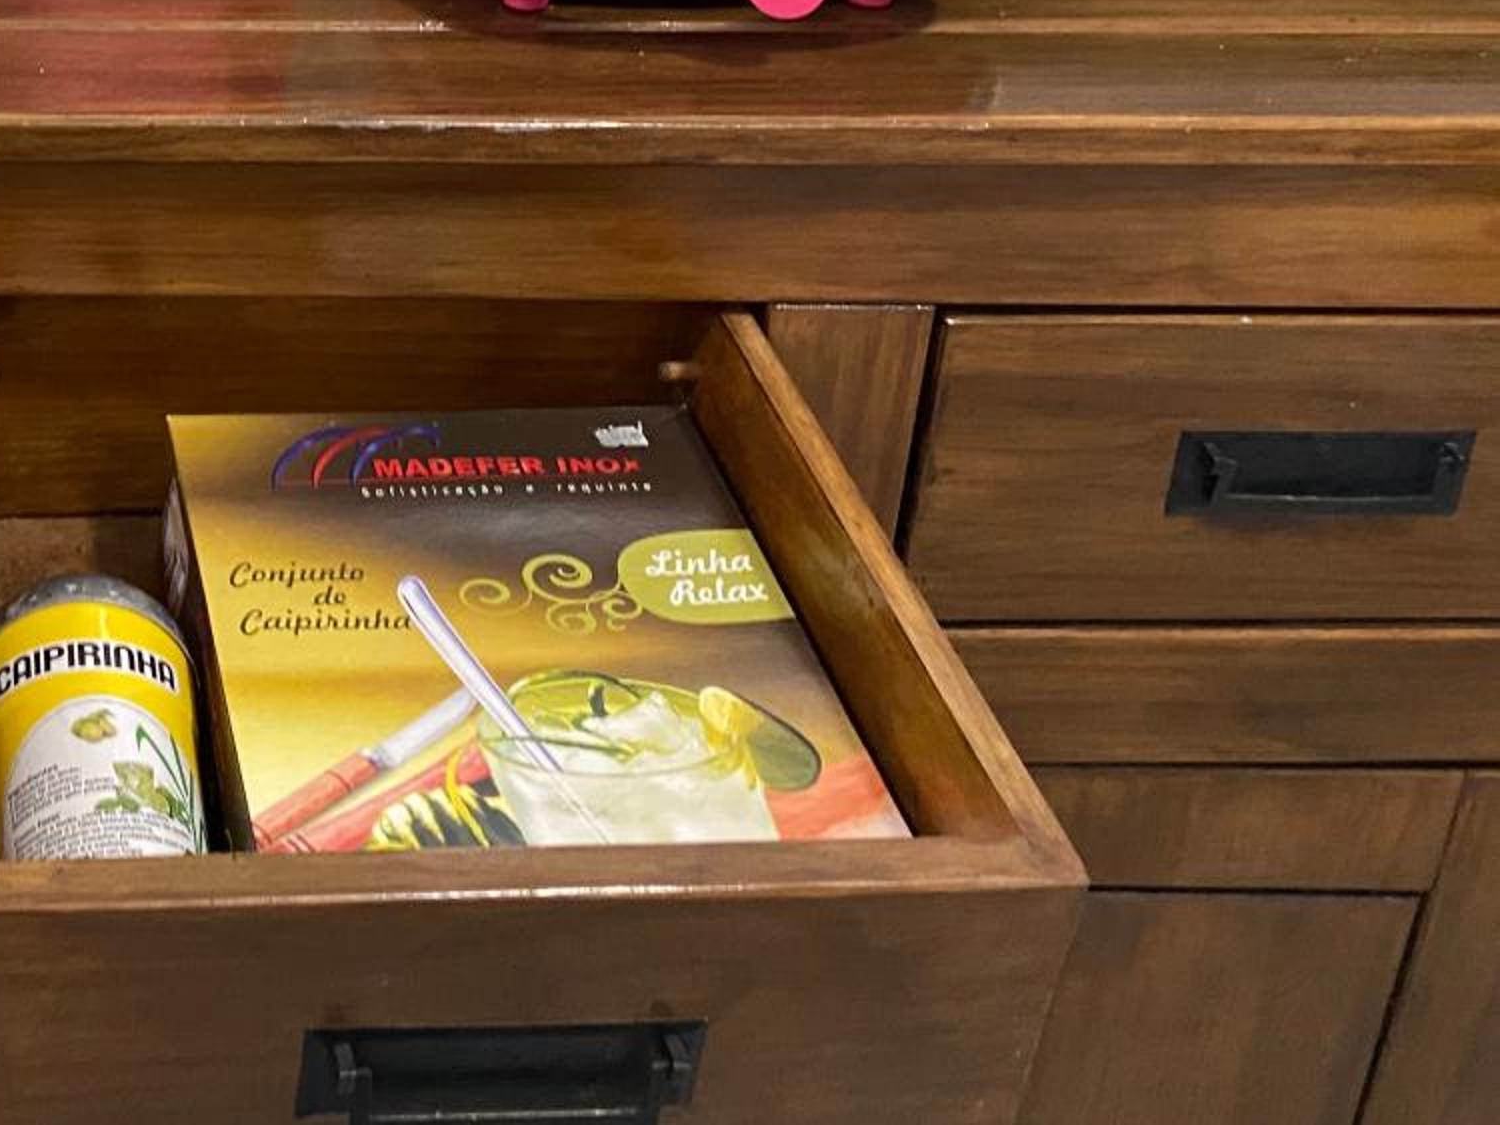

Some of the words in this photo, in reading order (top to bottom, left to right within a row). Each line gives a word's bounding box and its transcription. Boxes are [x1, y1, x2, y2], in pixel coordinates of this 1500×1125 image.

[372, 455, 547, 479] MADEFER
[556, 480, 652, 495] requinte
[228, 560, 366, 589] Conjunto
[645, 547, 754, 577] Linha
[312, 584, 348, 607] de
[669, 575, 770, 608] Relax
[238, 607, 412, 637] Caipirinha
